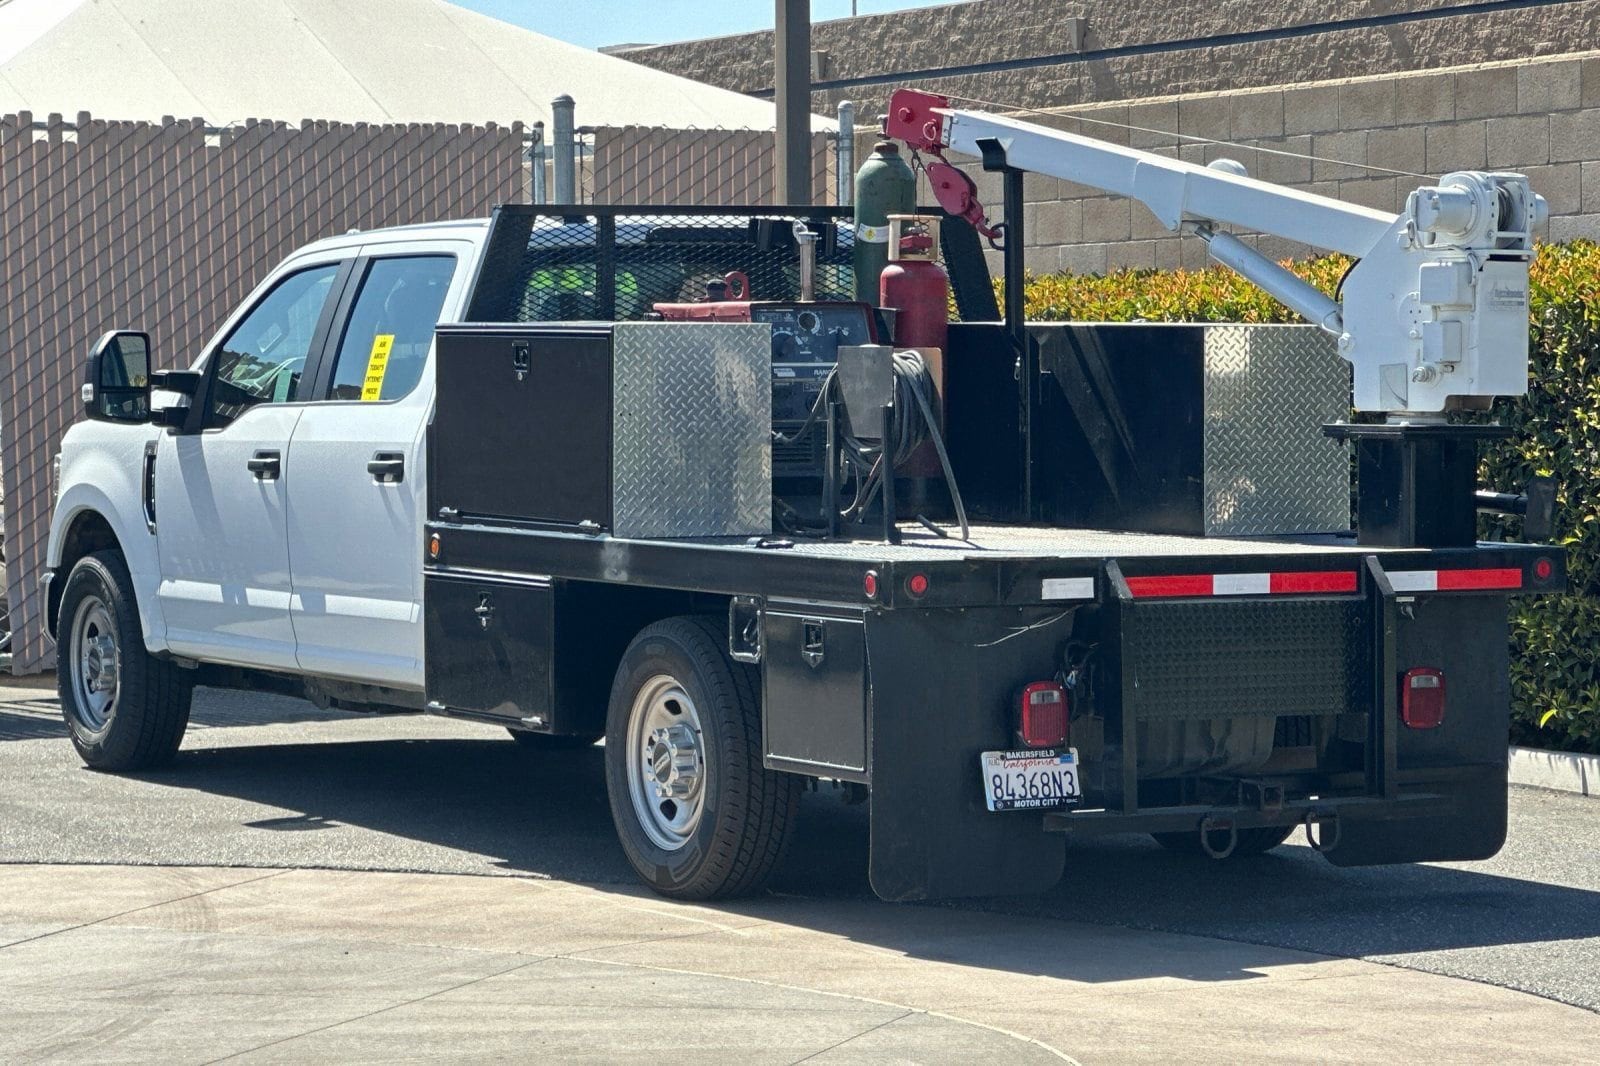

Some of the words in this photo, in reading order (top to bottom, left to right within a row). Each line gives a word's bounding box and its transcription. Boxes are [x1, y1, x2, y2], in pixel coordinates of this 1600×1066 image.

[1006, 749, 1055, 759] BAKERSFIELD
[1003, 759, 1059, 771] California
[992, 771, 1075, 800] 84368N3
[1014, 800, 1040, 808] MOTOR
[1042, 798, 1059, 806] CITY
